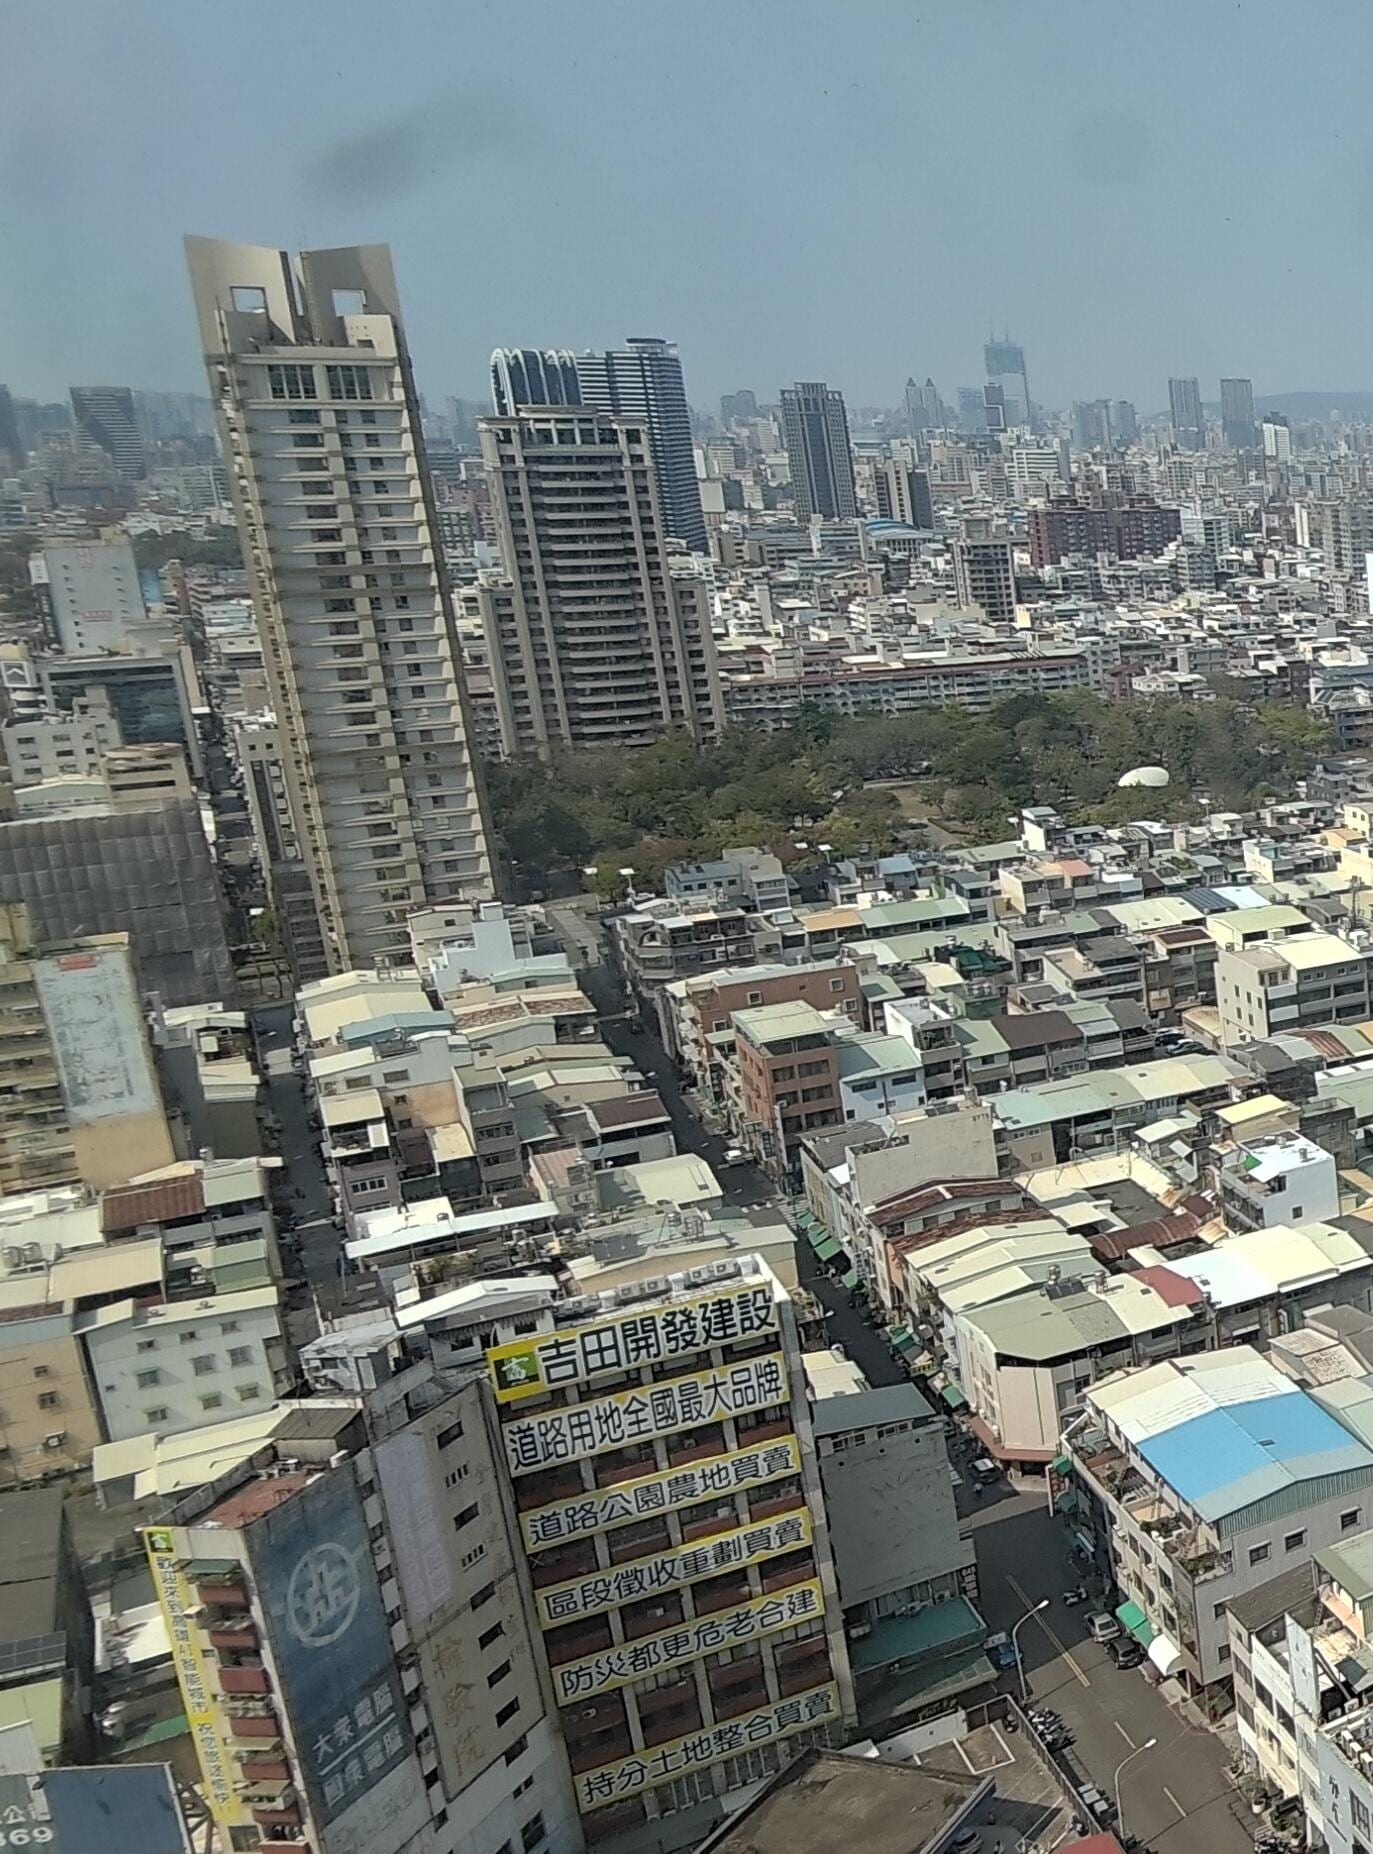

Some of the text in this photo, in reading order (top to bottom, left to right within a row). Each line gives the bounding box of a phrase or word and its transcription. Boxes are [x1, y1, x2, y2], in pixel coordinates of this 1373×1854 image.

[537, 1289, 777, 1386] 吉田開發建設
[508, 1360, 783, 1471] 道路用地全國最大品牌
[529, 1446, 795, 1546] 道路公園農地買賣
[543, 1516, 806, 1621] 區段徵收重劃買賣
[561, 1588, 818, 1698] 防災都更危老合建
[583, 1690, 836, 1804] 持分土地整合買賣
